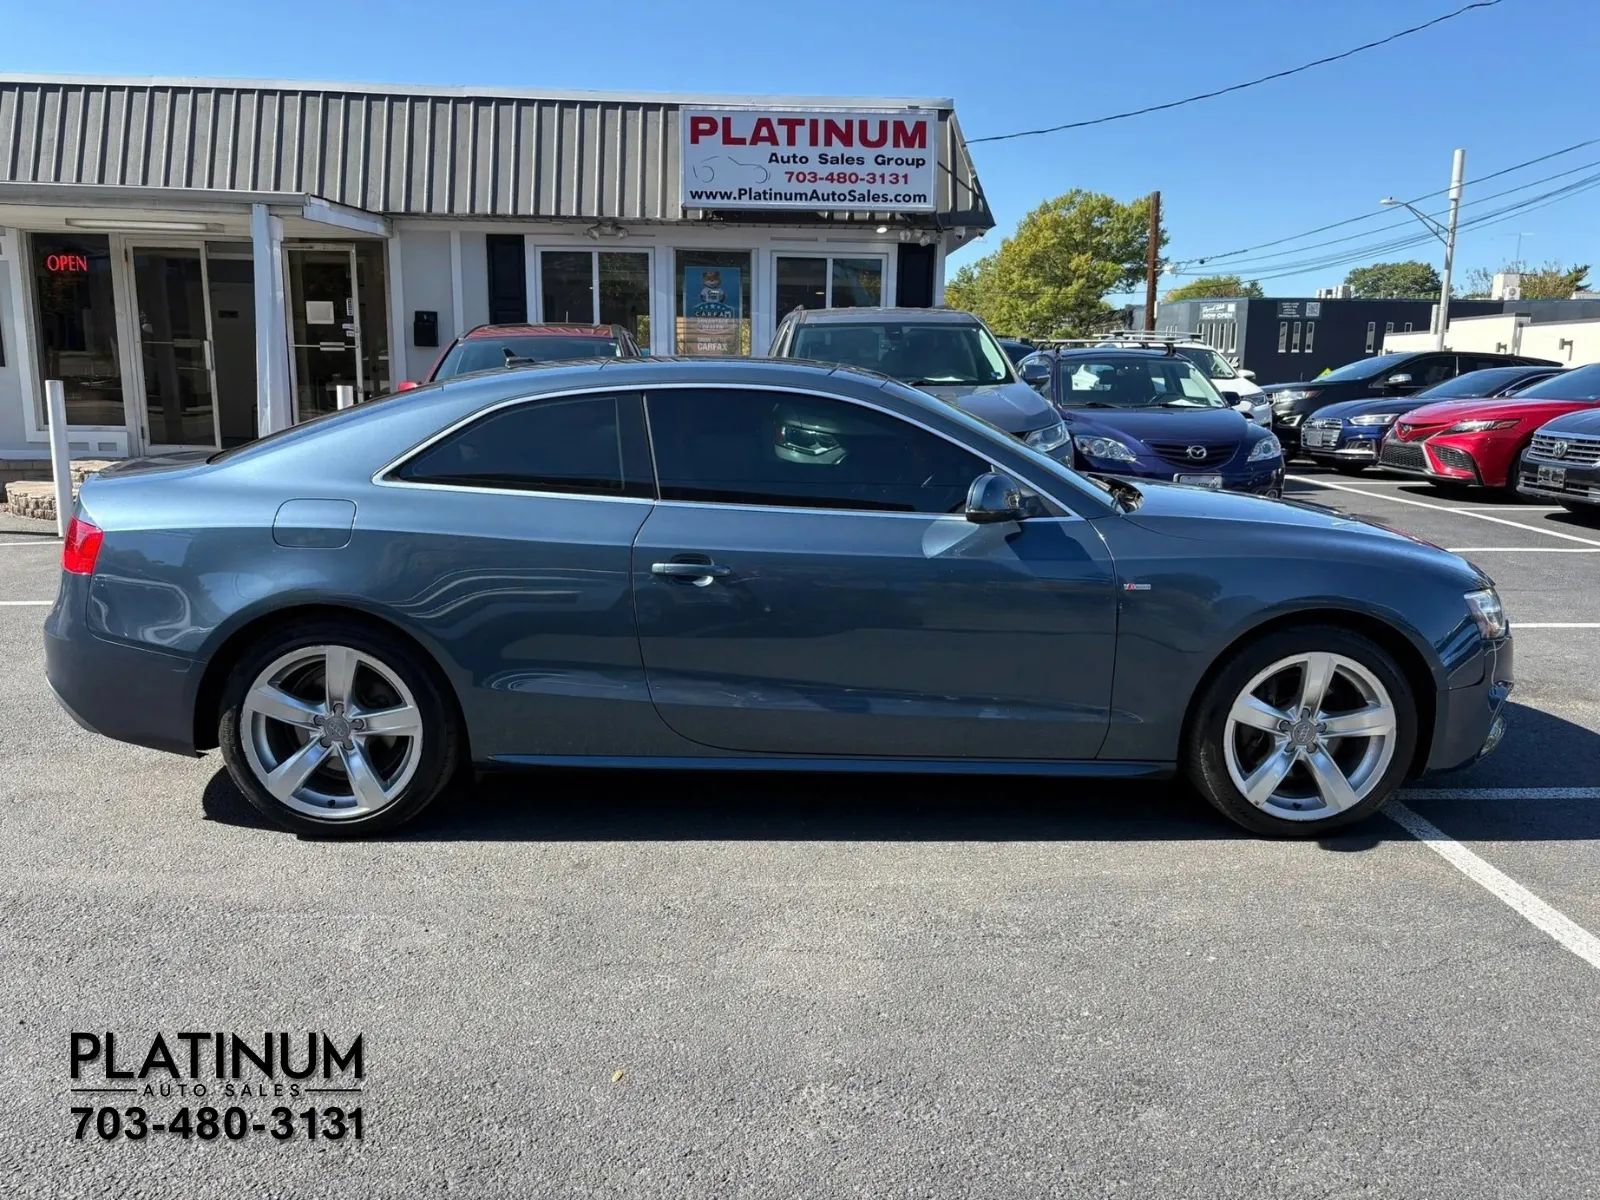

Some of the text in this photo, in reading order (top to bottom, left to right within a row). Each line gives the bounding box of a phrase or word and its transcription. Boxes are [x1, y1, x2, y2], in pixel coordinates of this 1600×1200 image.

[690, 116, 927, 149] PLATINUM
[768, 153, 926, 168] Auto Sales Group
[785, 171, 909, 185] 703-480-3131
[690, 188, 927, 203] www.PlatinumAutoSales.com
[47, 255, 87, 271] OPEN
[697, 342, 728, 351] CARFAX
